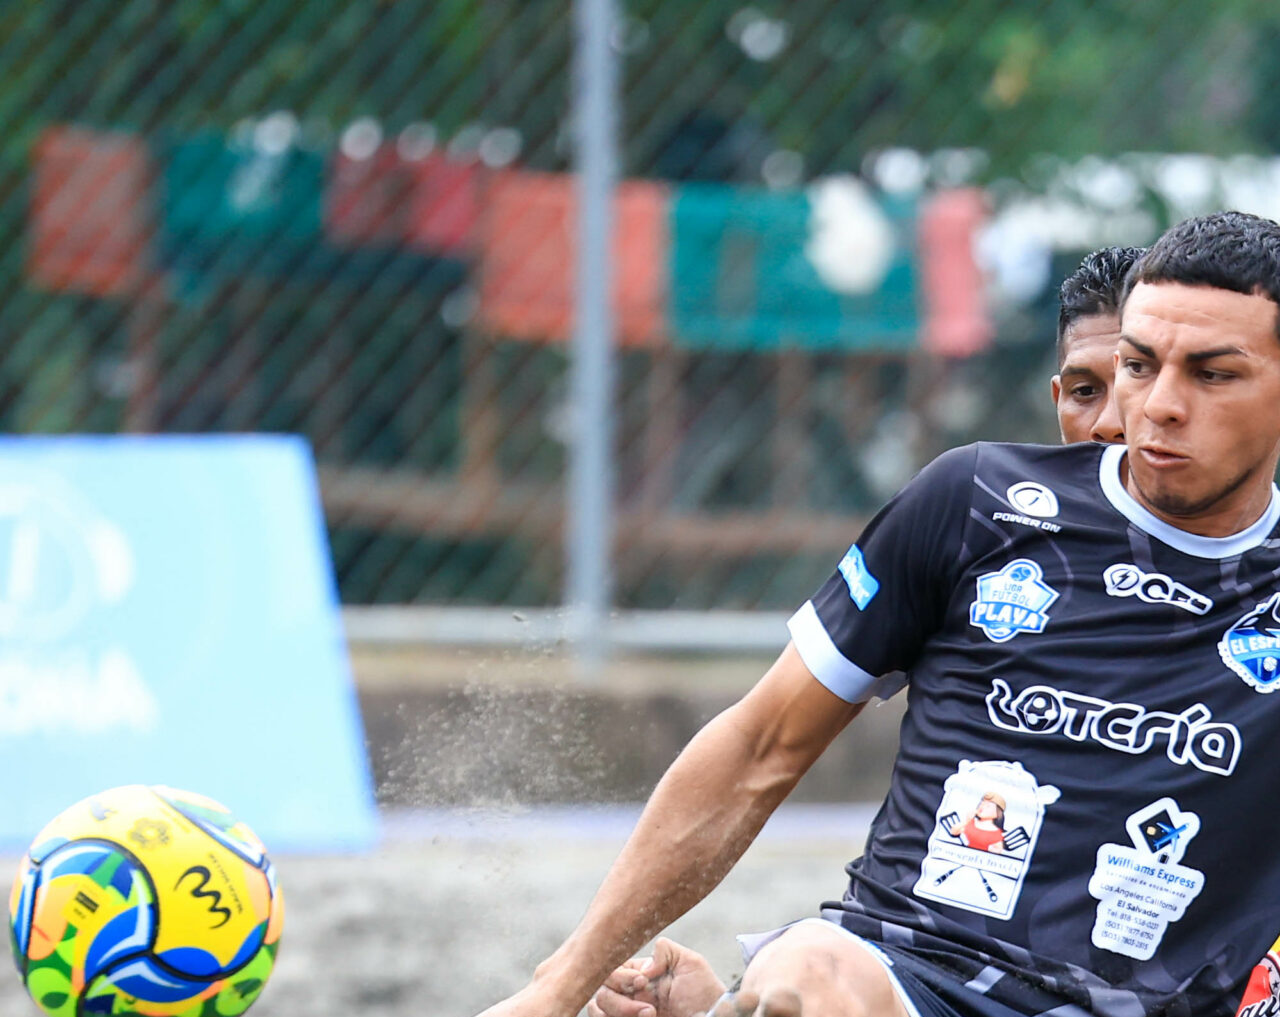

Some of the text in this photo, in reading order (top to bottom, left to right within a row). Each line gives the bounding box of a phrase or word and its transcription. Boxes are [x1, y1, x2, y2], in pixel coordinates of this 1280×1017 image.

[992, 512, 1062, 533] POWER ON
[1004, 582, 1023, 592] LIGA
[992, 590, 1031, 606] FUTBOL
[974, 603, 1038, 629] PLAYA
[1230, 638, 1249, 655] EL
[1107, 855, 1196, 889] Williams Express
[1114, 886, 1144, 901] Angeles
[1116, 899, 1160, 918] El Salvador
